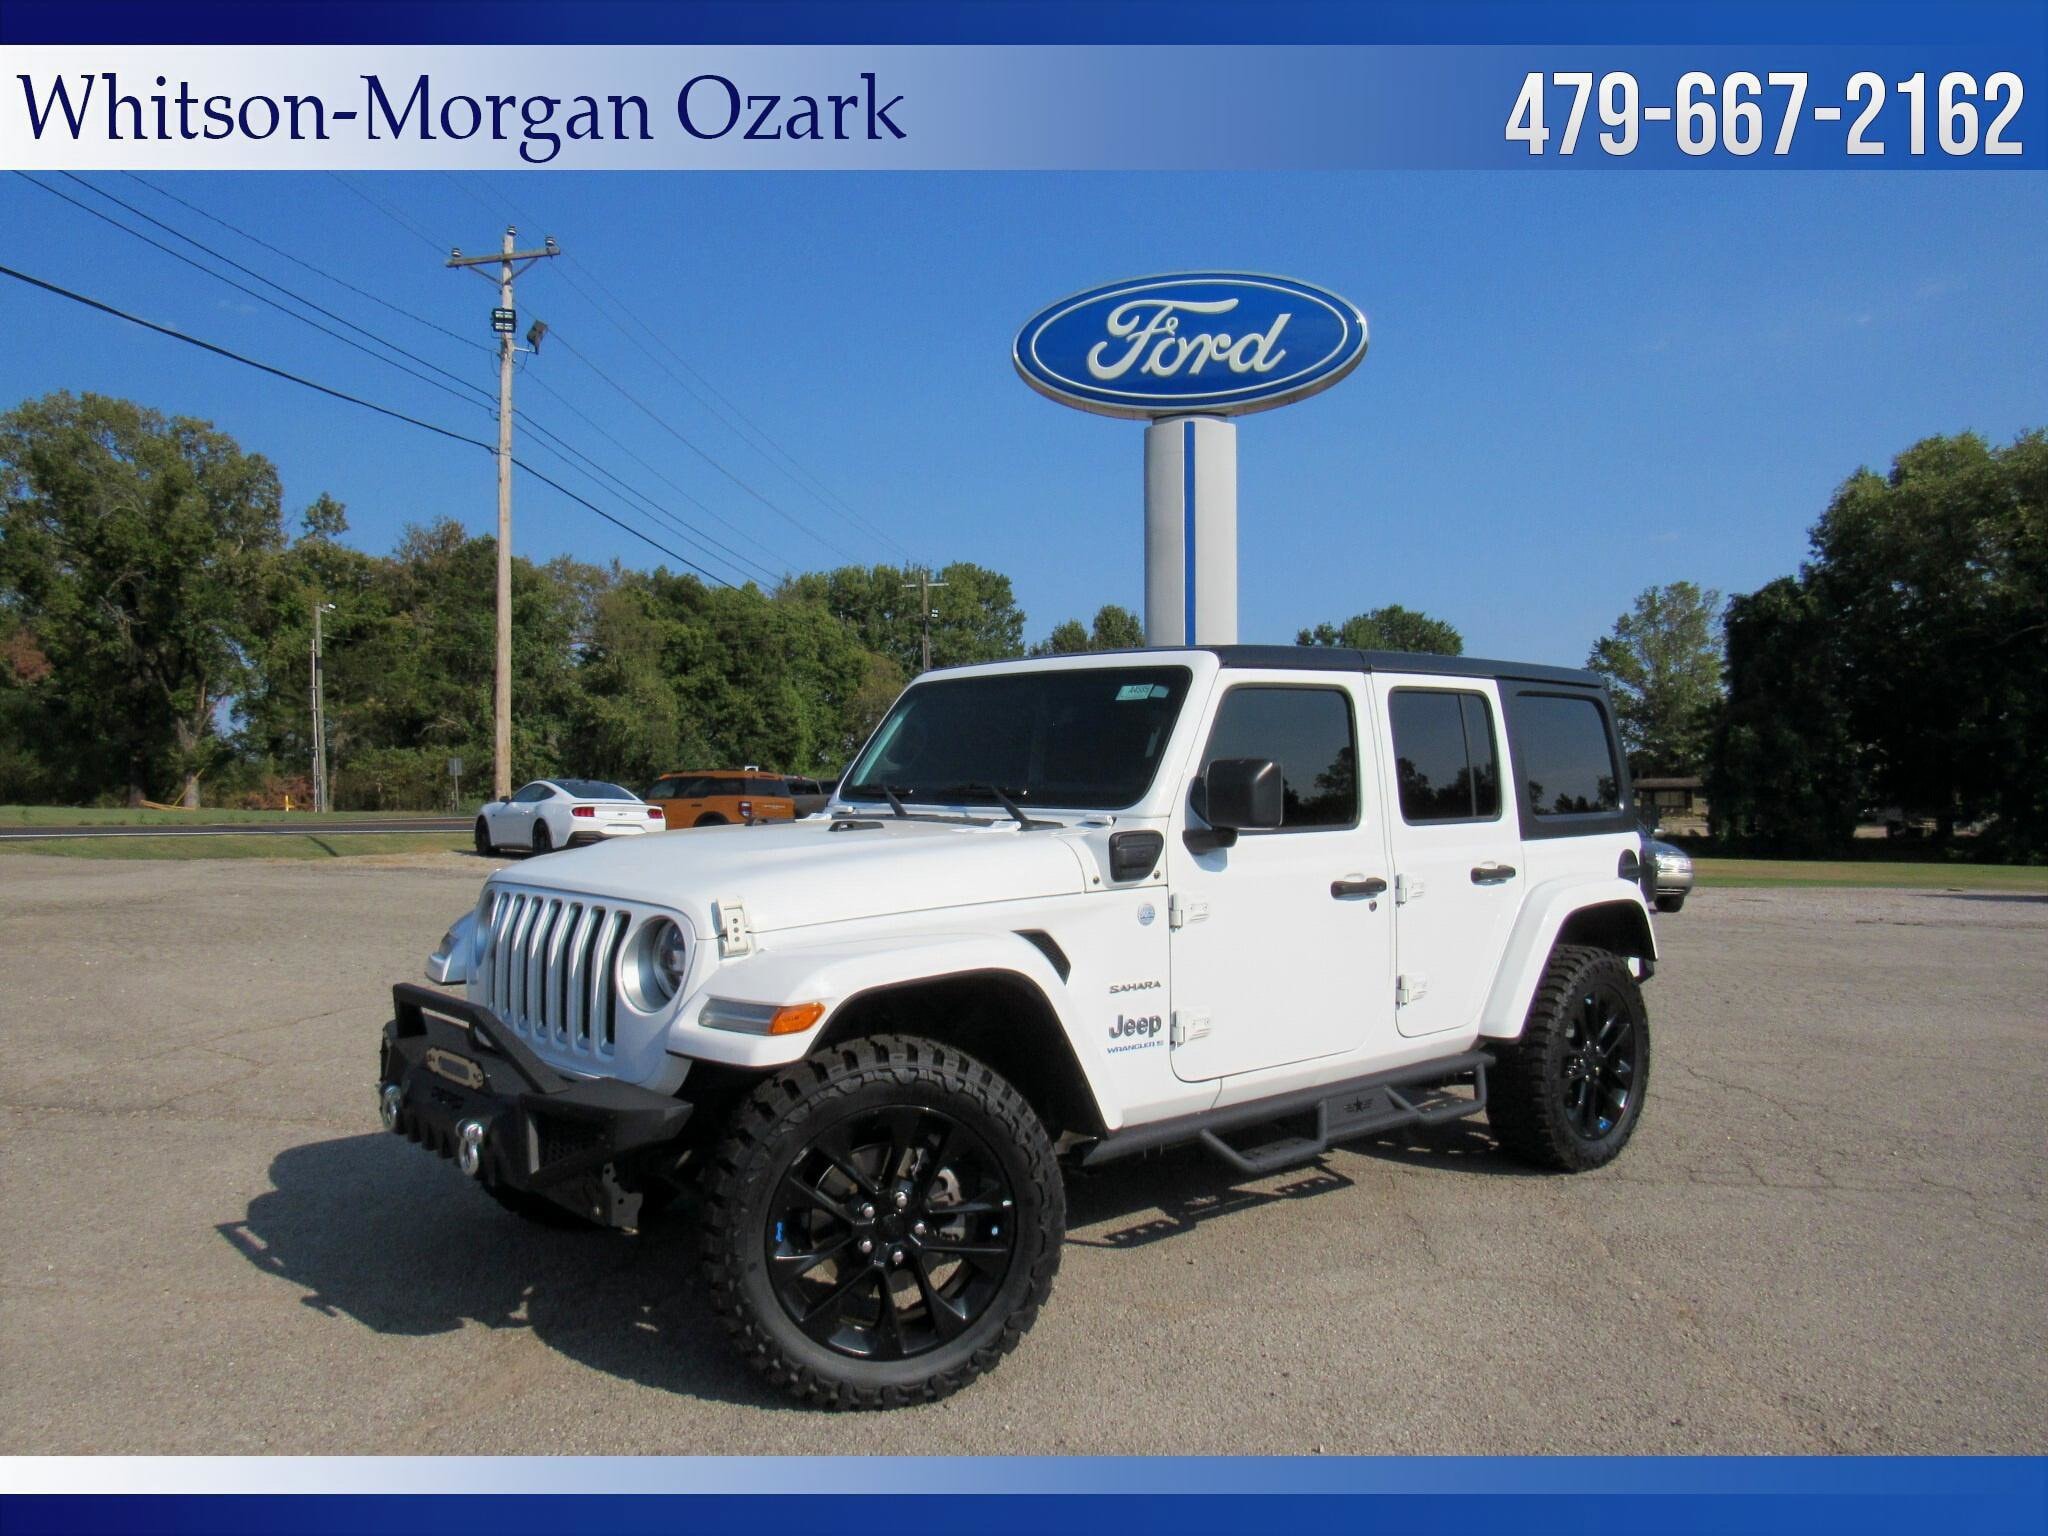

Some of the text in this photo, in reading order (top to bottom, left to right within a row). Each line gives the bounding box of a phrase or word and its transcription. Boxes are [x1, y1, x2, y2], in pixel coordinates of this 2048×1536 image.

[1087, 298, 1292, 380] Ford
[1109, 981, 1161, 994] SAHARA
[1108, 1014, 1162, 1039] Jeep
